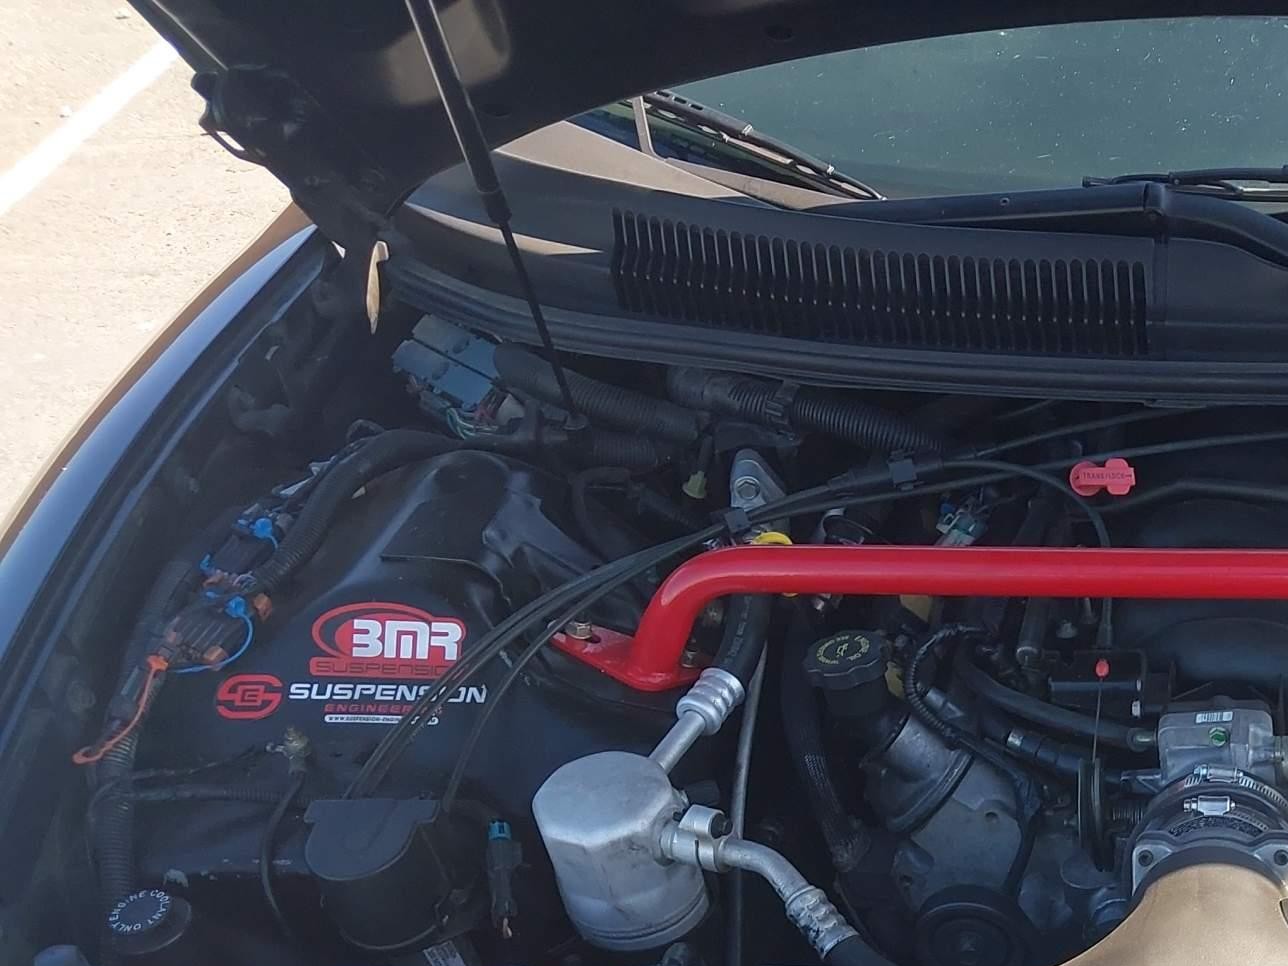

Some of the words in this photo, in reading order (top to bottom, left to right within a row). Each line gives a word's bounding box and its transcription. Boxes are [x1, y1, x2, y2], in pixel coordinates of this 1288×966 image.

[352, 619, 462, 660] BMR
[314, 662, 452, 677] SUSPENSIO
[324, 703, 442, 714] ENGINEER
[109, 889, 147, 922] ENGINE
[147, 889, 170, 925] COOLANT
[111, 920, 142, 933] ONLY
